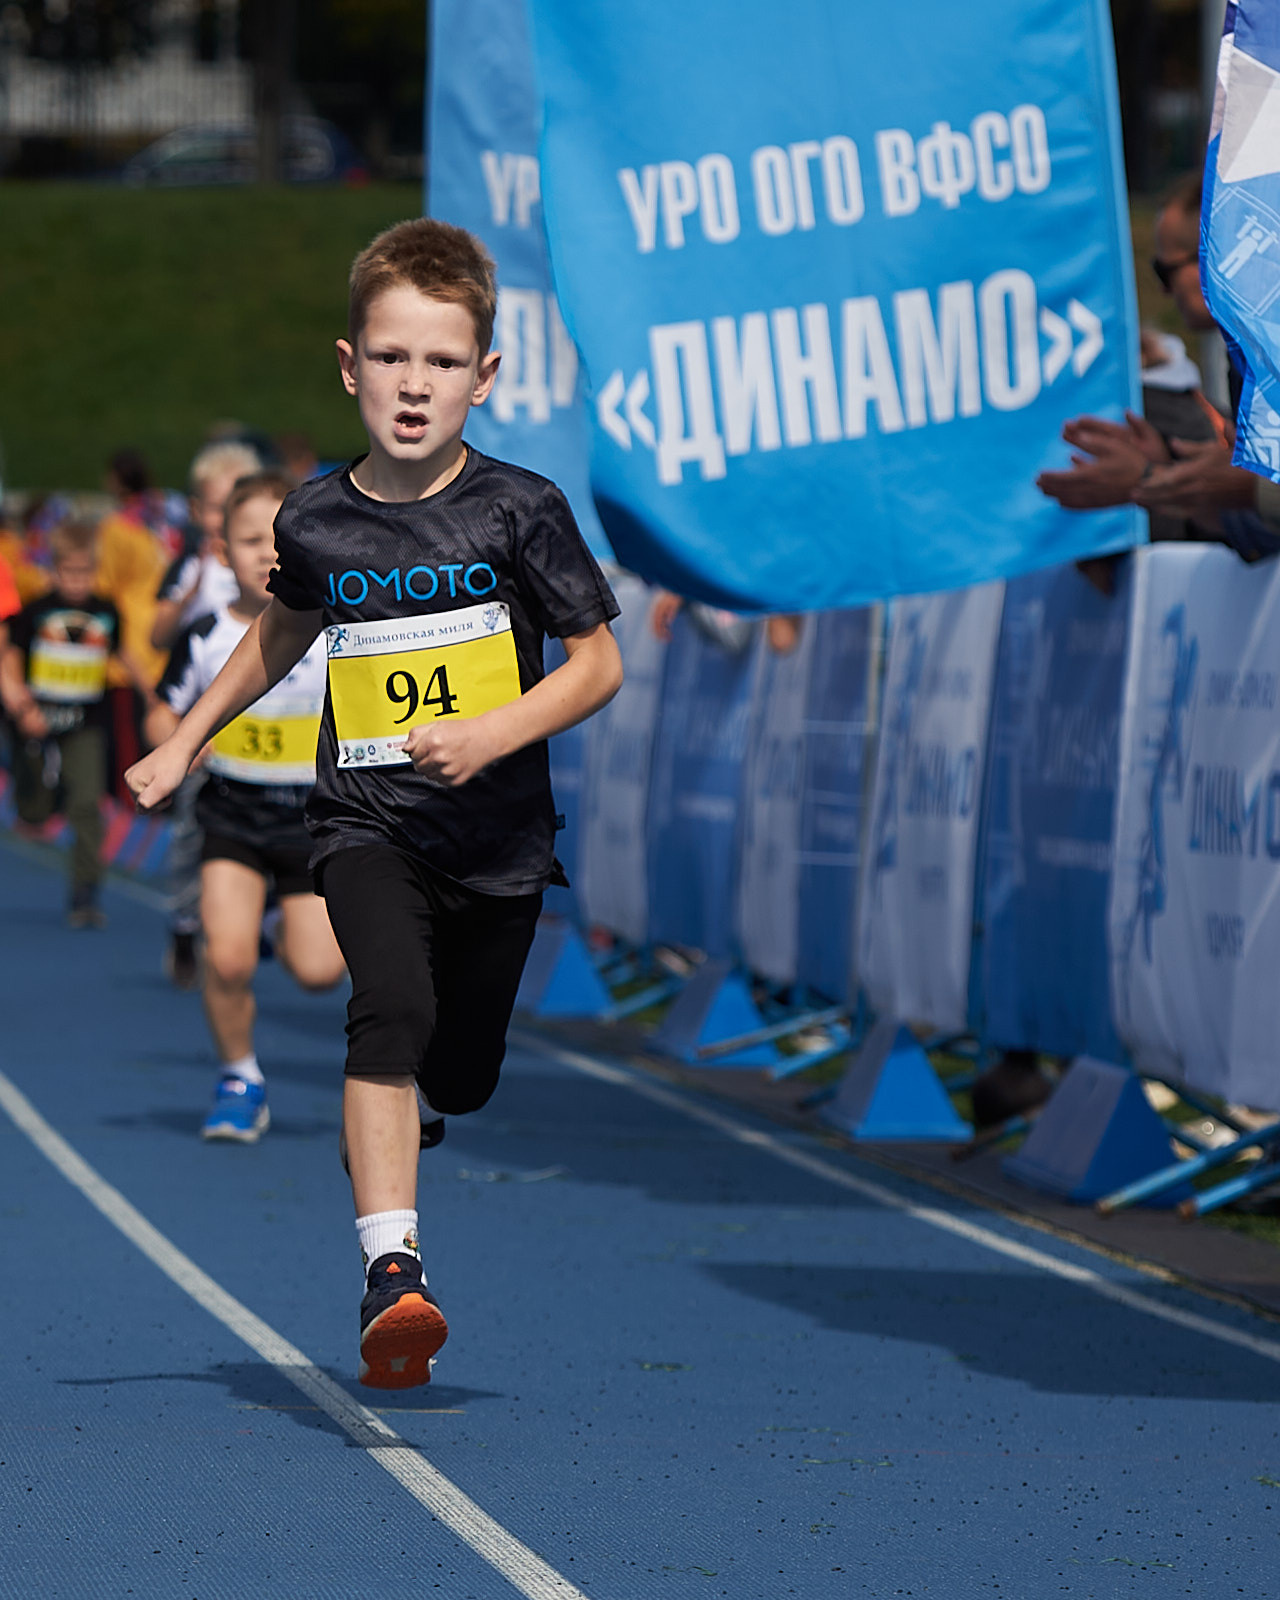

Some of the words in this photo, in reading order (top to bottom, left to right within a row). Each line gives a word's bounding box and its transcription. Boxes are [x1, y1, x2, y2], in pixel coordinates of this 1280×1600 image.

[617, 151, 741, 254] УРО
[749, 133, 865, 237] ОГО
[873, 103, 1052, 218] ВФСО
[597, 267, 1105, 486] «ДИНАМО»
[323, 562, 498, 607] JOMOTO
[352, 629, 435, 648] Динамовская
[438, 621, 474, 637] миля
[385, 664, 460, 725] 94
[241, 722, 283, 762] 33
